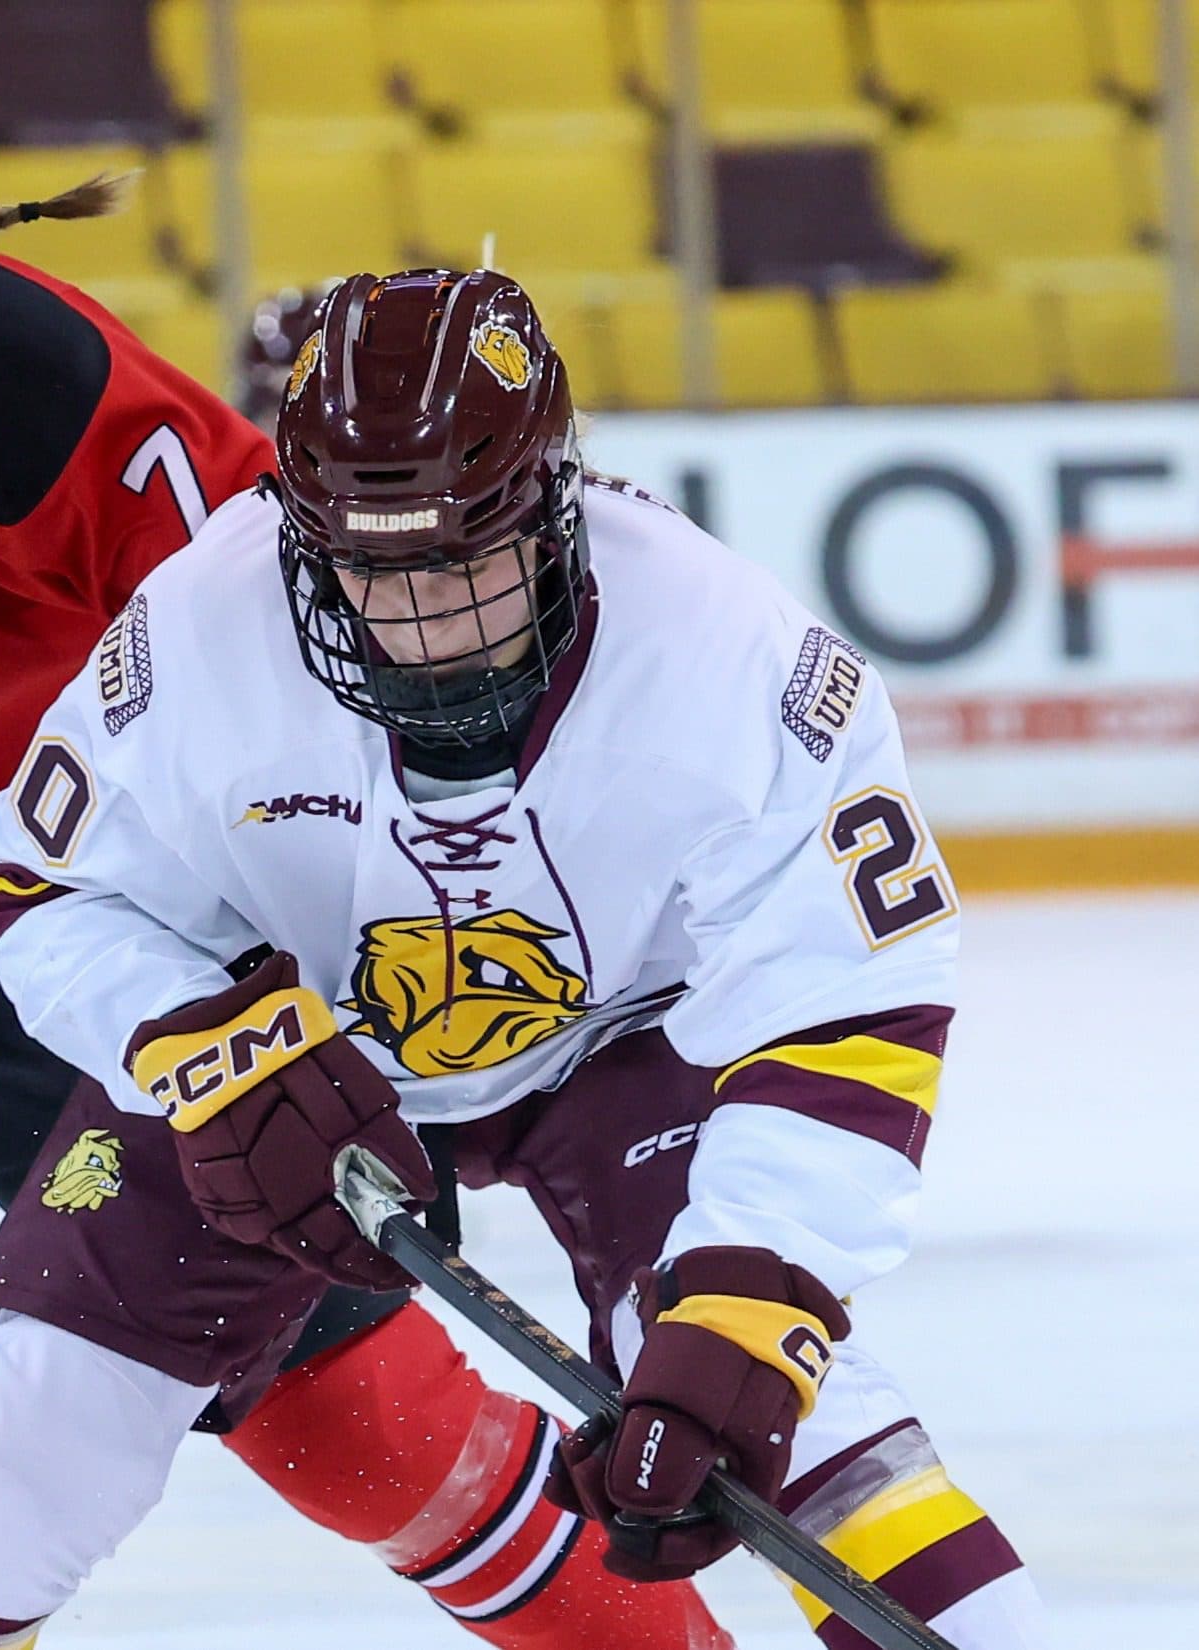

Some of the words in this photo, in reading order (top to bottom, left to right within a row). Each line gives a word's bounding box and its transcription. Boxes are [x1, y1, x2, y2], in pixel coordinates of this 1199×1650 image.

[119, 421, 210, 543] 7
[346, 509, 439, 532] BULLDOGS
[98, 618, 124, 702] UMD
[814, 655, 862, 729] UMD
[821, 784, 959, 953] 2
[149, 1001, 307, 1122] CCM
[623, 1121, 701, 1169] CC
[636, 1418, 666, 1490] CCM
